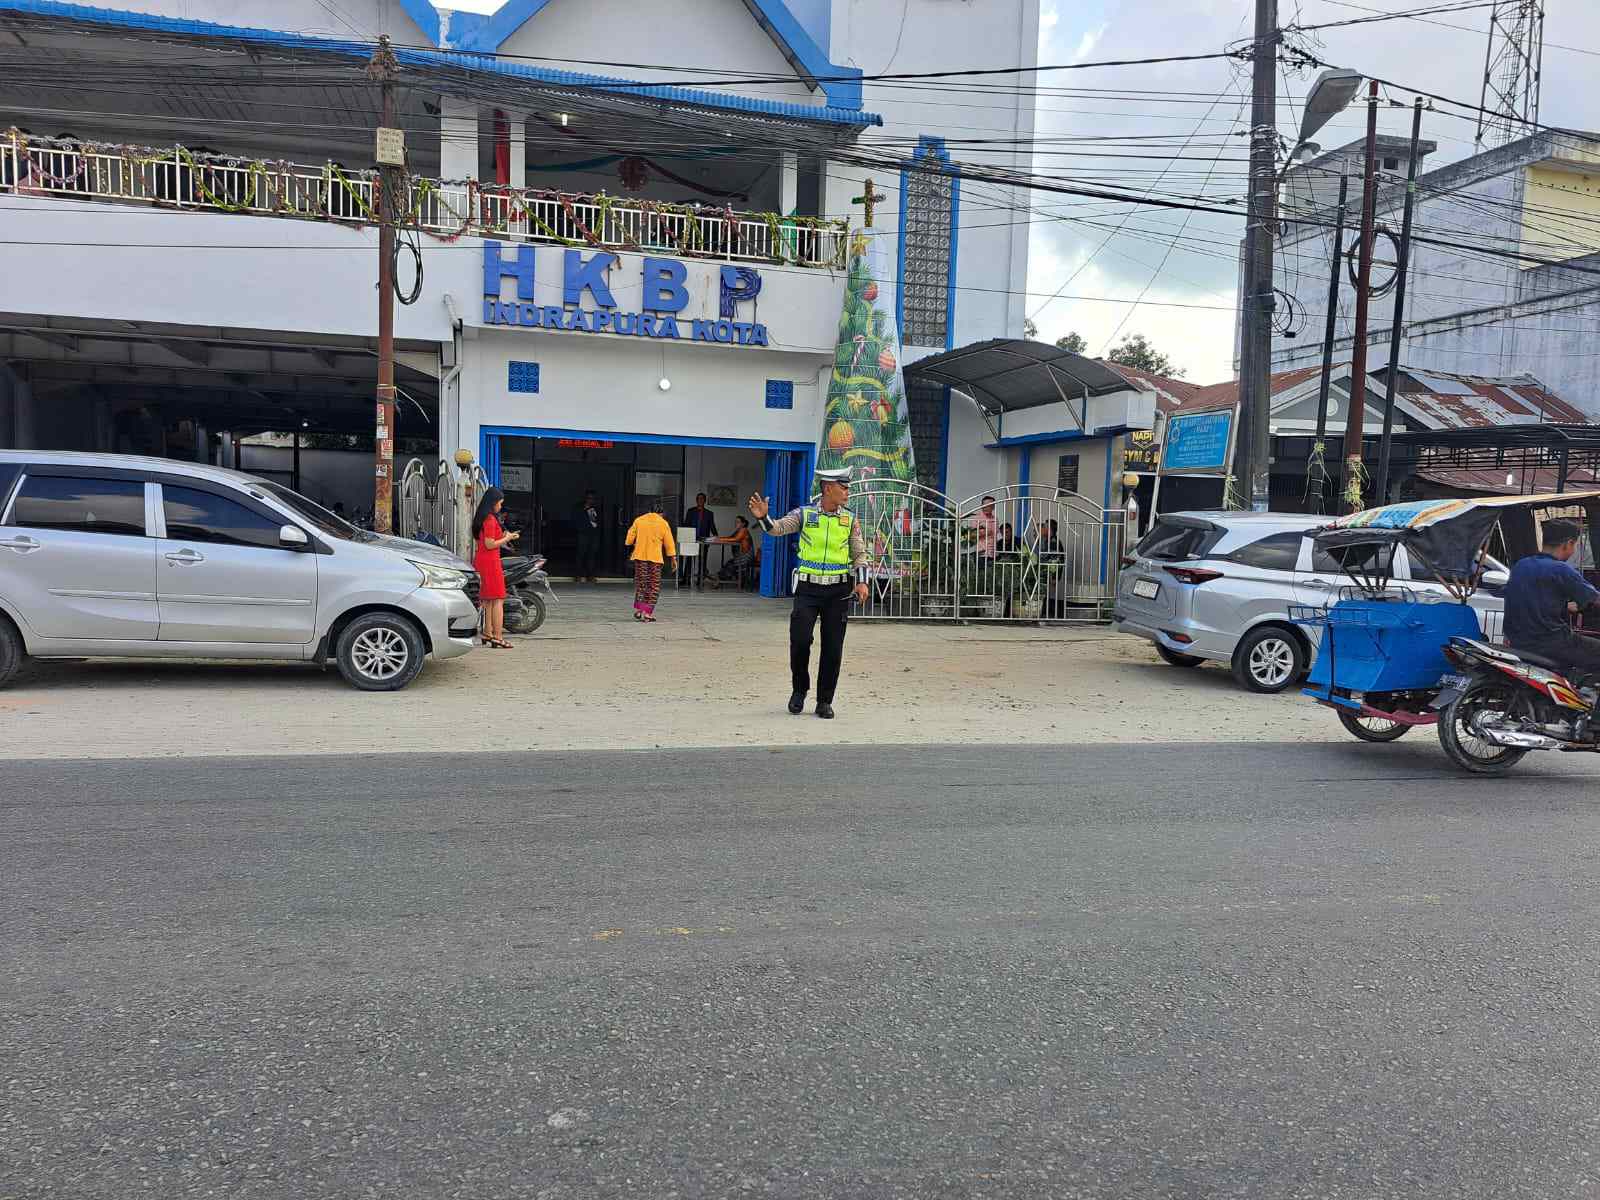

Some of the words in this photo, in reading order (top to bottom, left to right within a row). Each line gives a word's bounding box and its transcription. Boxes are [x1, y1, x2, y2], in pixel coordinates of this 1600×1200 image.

[484, 240, 762, 318] HKBP
[483, 300, 681, 338] INDRAPURA
[692, 319, 769, 346] KOTA
